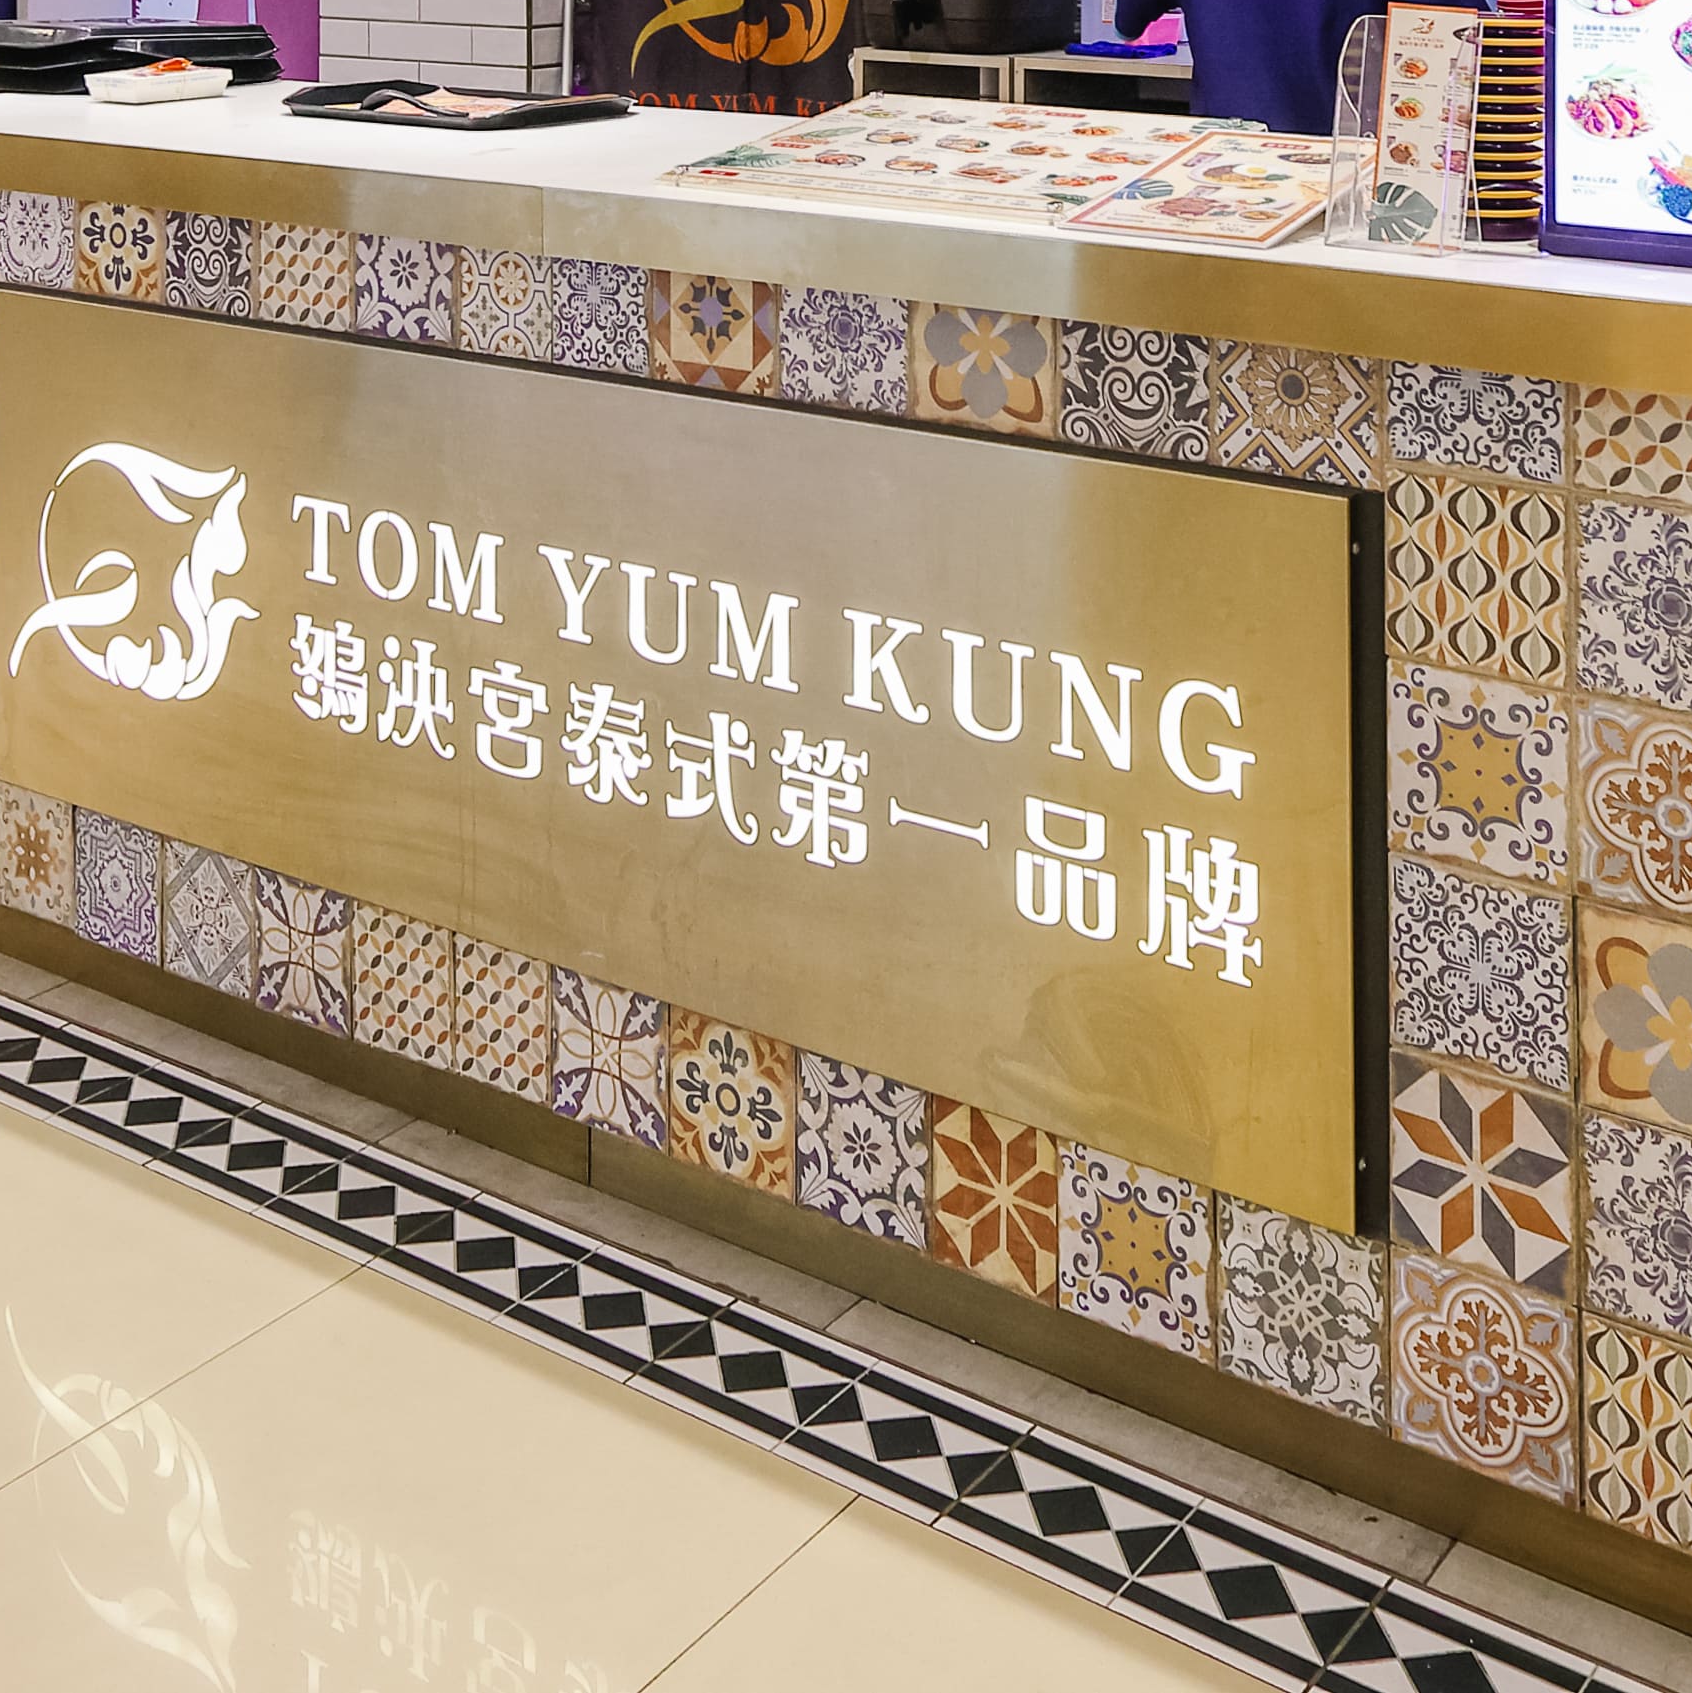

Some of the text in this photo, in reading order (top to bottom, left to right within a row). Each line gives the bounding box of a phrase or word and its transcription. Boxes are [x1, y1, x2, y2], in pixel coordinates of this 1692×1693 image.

[290, 494, 1258, 801] TOM YUM KUNG
